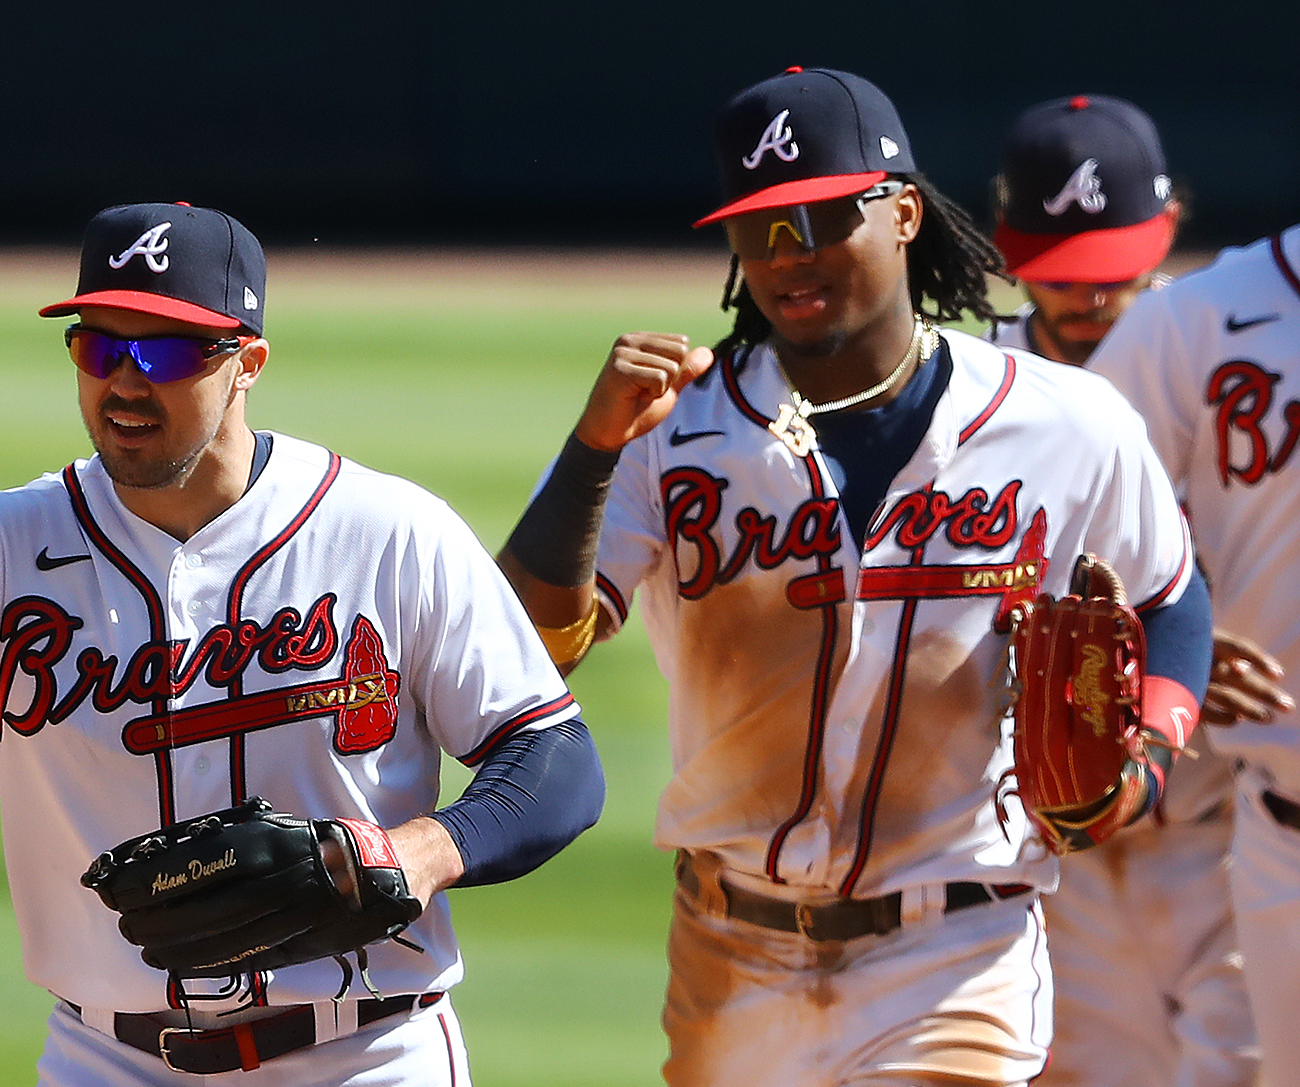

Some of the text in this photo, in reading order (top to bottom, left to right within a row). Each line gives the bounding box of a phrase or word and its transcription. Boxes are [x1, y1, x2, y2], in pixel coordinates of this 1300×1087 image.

[742, 108, 800, 169] A
[1043, 158, 1106, 216] A
[108, 220, 173, 274] A
[660, 467, 1022, 600] Braves
[151, 848, 237, 896] Adam Duvall
